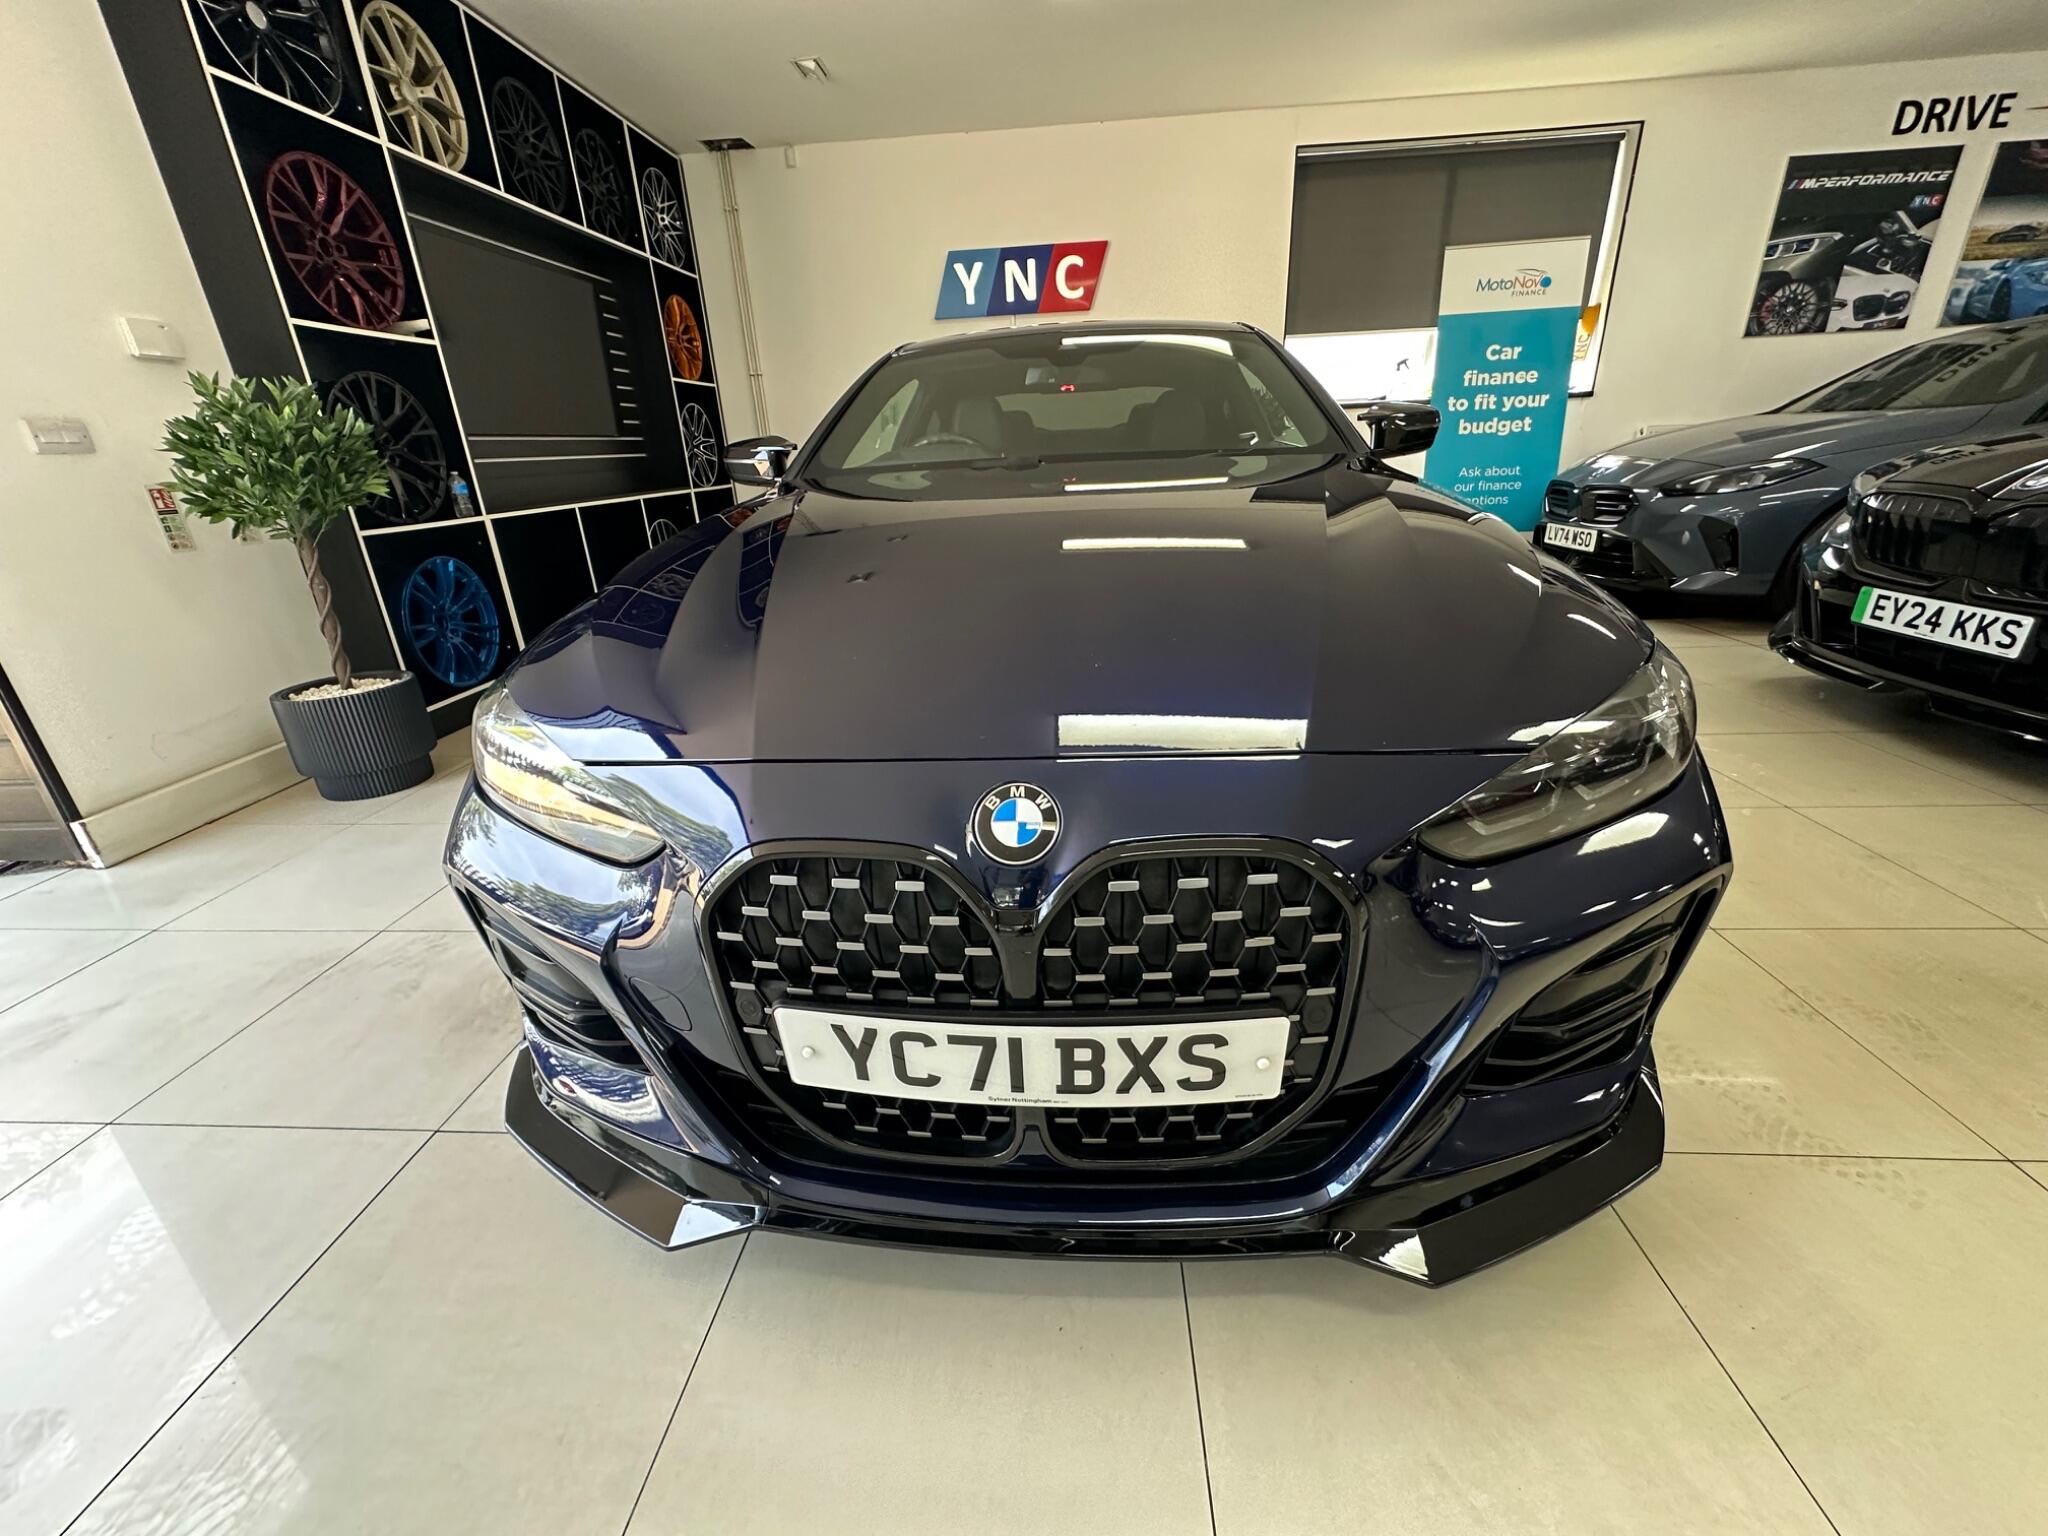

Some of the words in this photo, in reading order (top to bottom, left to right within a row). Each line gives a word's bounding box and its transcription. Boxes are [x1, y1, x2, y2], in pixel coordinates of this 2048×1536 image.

[1892, 92, 2018, 135] DRIVE
[953, 255, 1084, 305] YNC
[1511, 289, 1546, 297] FINANCE
[1486, 344, 1522, 361] Car
[1463, 370, 1539, 386] finance
[1448, 397, 1468, 411] to
[1474, 395, 1496, 409] fit
[1502, 393, 1549, 411] your
[1458, 417, 1532, 435] budget
[1459, 466, 1481, 477] Ask
[1484, 465, 1520, 477] about
[1454, 484, 1474, 492] our
[1478, 480, 1522, 491] finance
[1548, 526, 1570, 543] LV74
[1571, 530, 1592, 547] WSO
[1869, 594, 1945, 633] EY24
[1949, 610, 2024, 650] KKS
[984, 786, 1052, 810] BMW
[830, 1023, 1025, 1093] YC71
[1055, 1033, 1230, 1096] BXS
